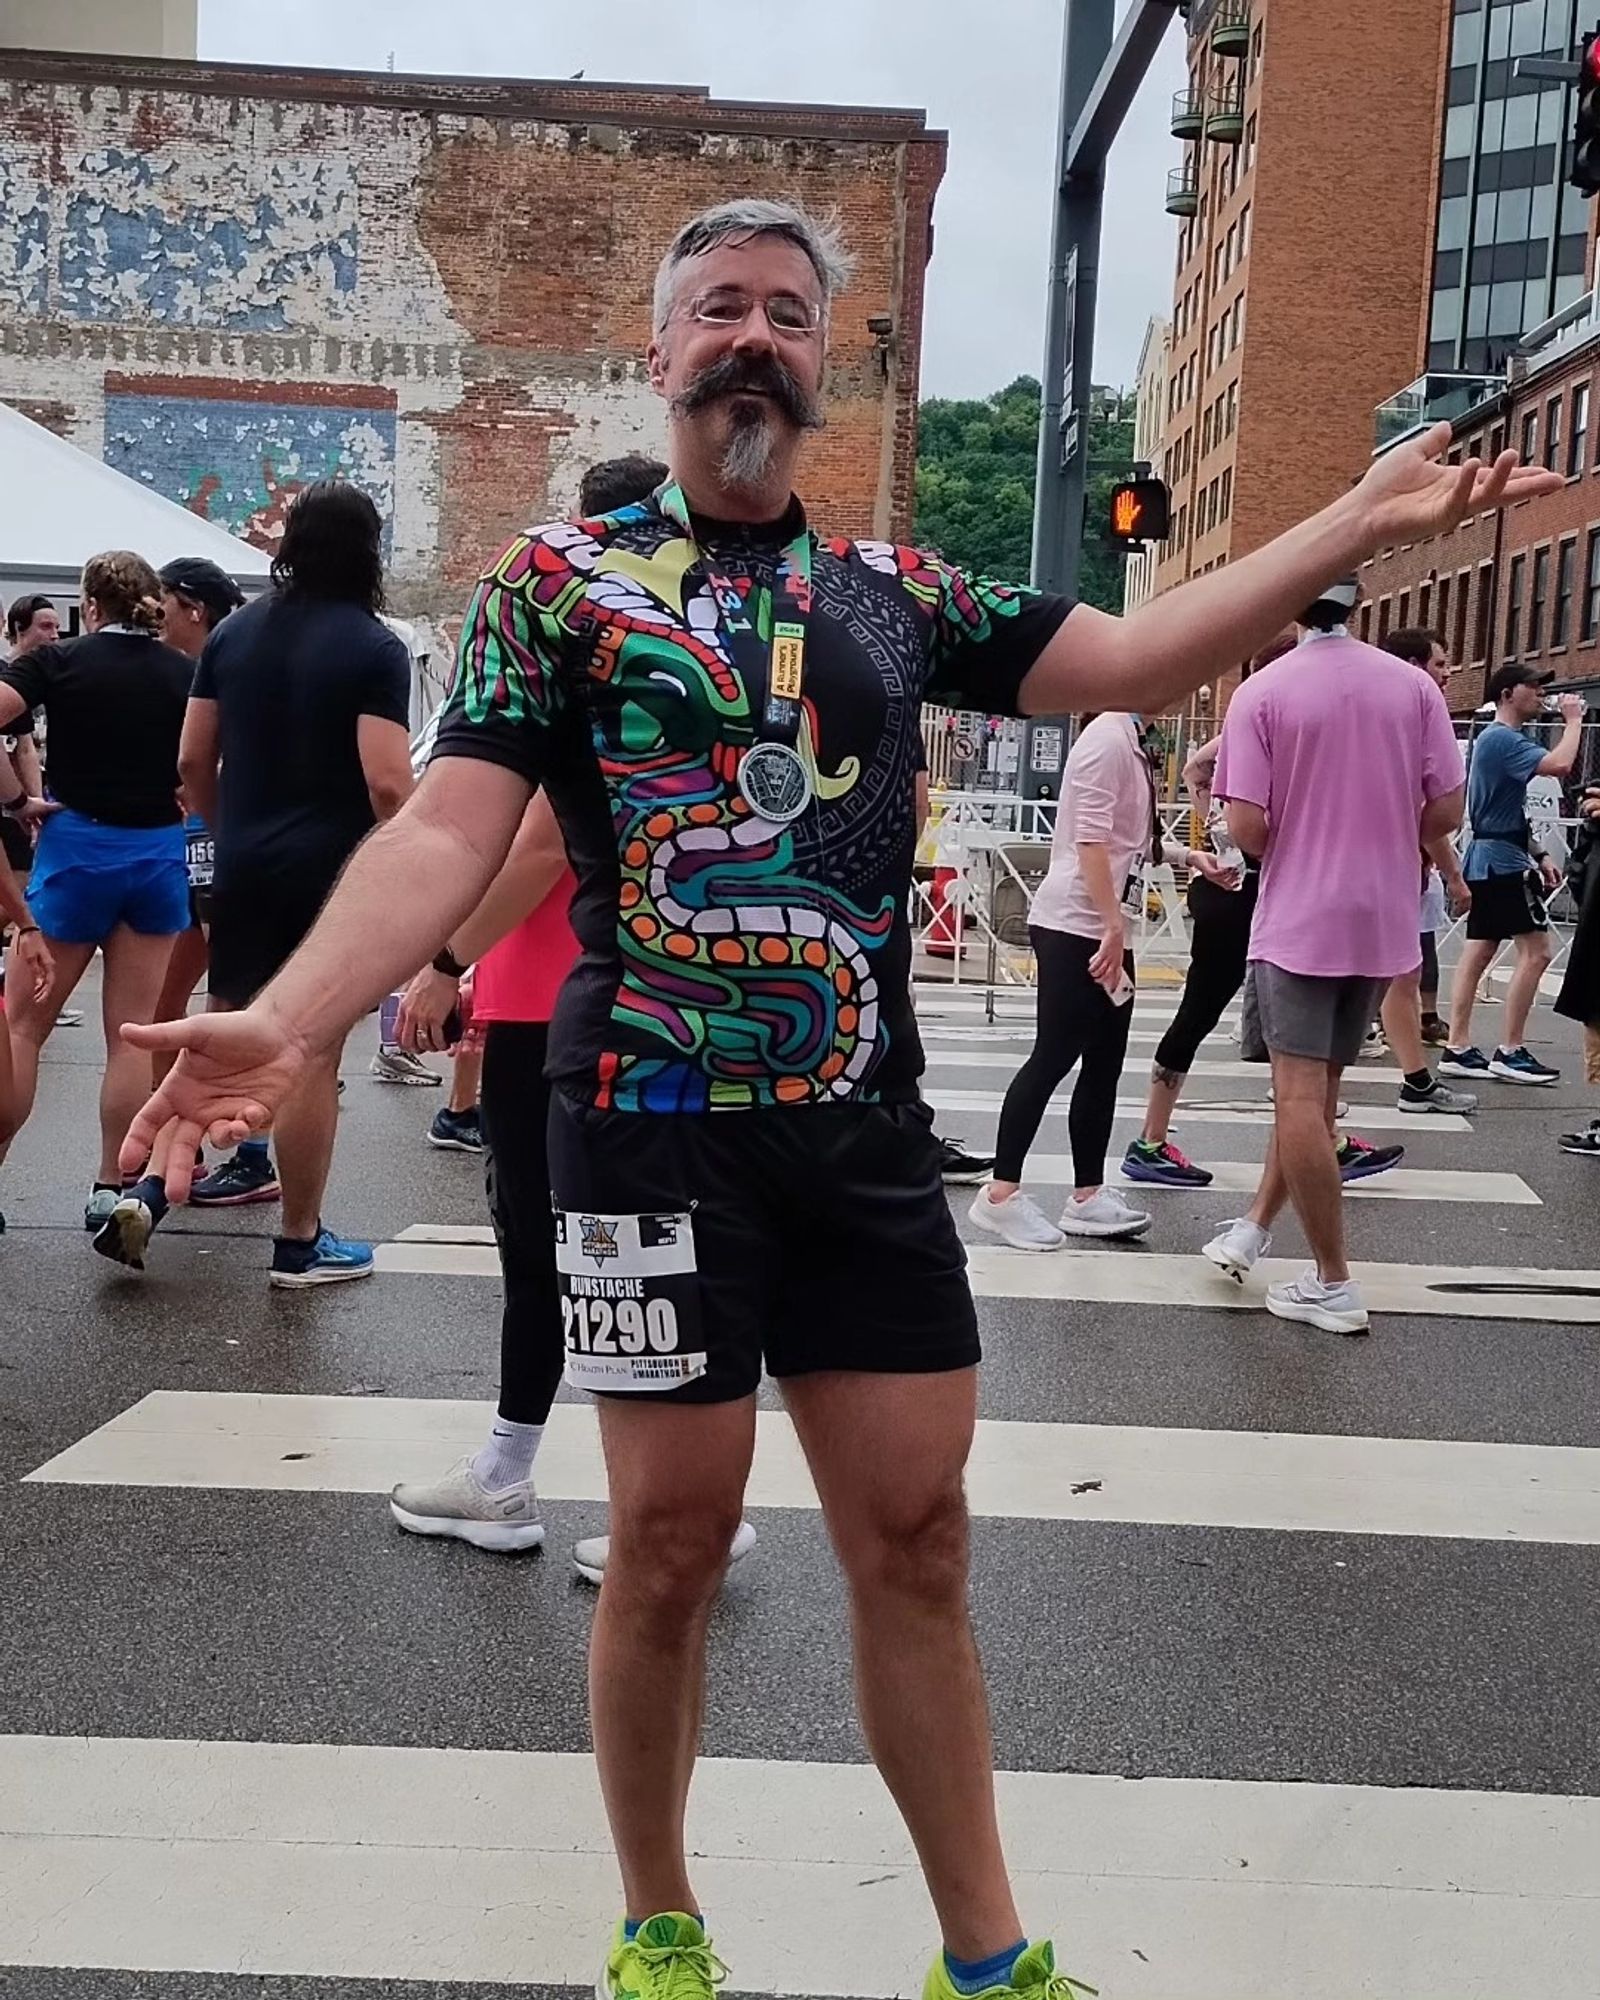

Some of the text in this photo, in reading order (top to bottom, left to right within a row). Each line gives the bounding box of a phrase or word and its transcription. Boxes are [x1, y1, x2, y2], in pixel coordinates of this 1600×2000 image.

[708, 572, 752, 633] 13.1
[787, 643, 798, 693] Playground
[777, 684, 785, 692] A
[561, 1294, 678, 1353] 21290
[631, 1358, 680, 1369] PITTSBURGH
[638, 1368, 681, 1379] MARATHON
